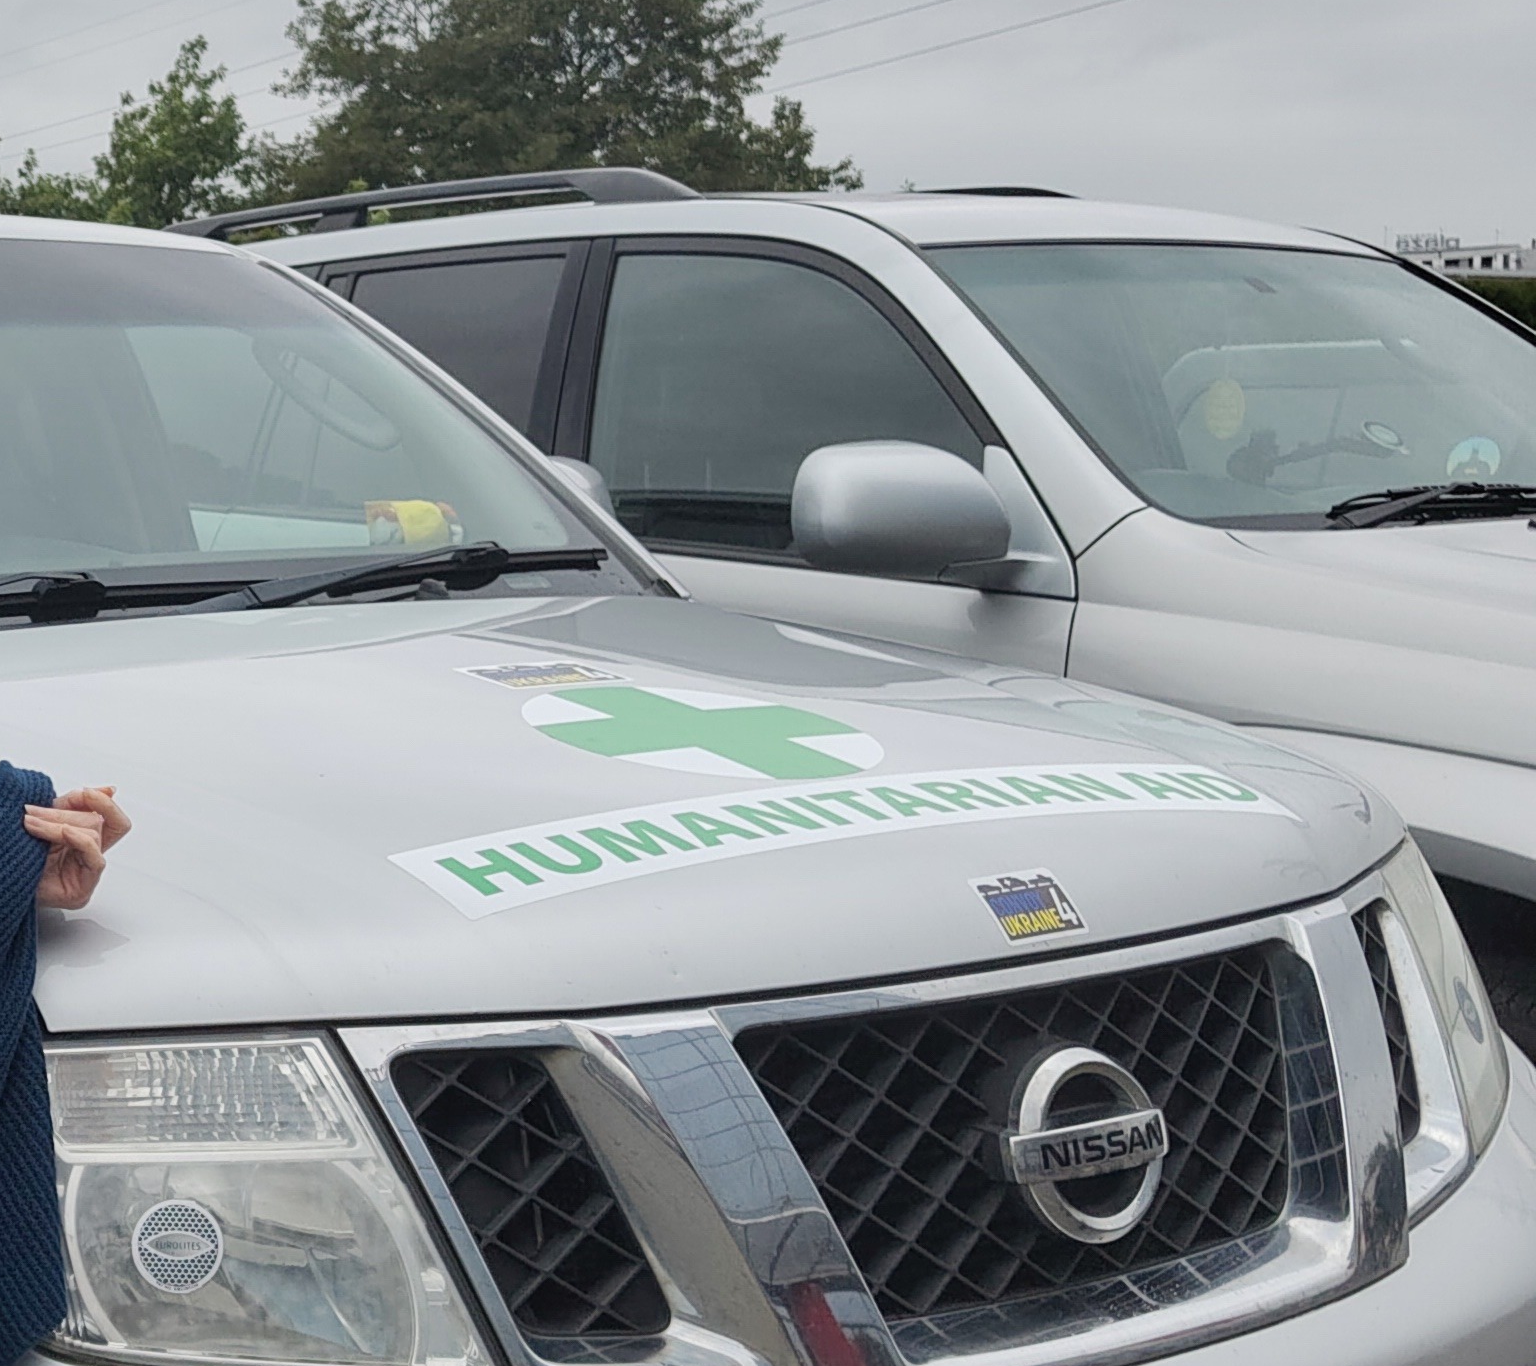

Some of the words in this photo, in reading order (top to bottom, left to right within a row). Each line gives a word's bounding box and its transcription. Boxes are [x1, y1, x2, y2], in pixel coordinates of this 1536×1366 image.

[434, 773, 1135, 897] HUMANITARIAN
[1118, 771, 1260, 802] AID
[1000, 907, 1065, 937] UKRAINE
[1048, 886, 1079, 926] 4
[1040, 1113, 1165, 1171] NISSAN
